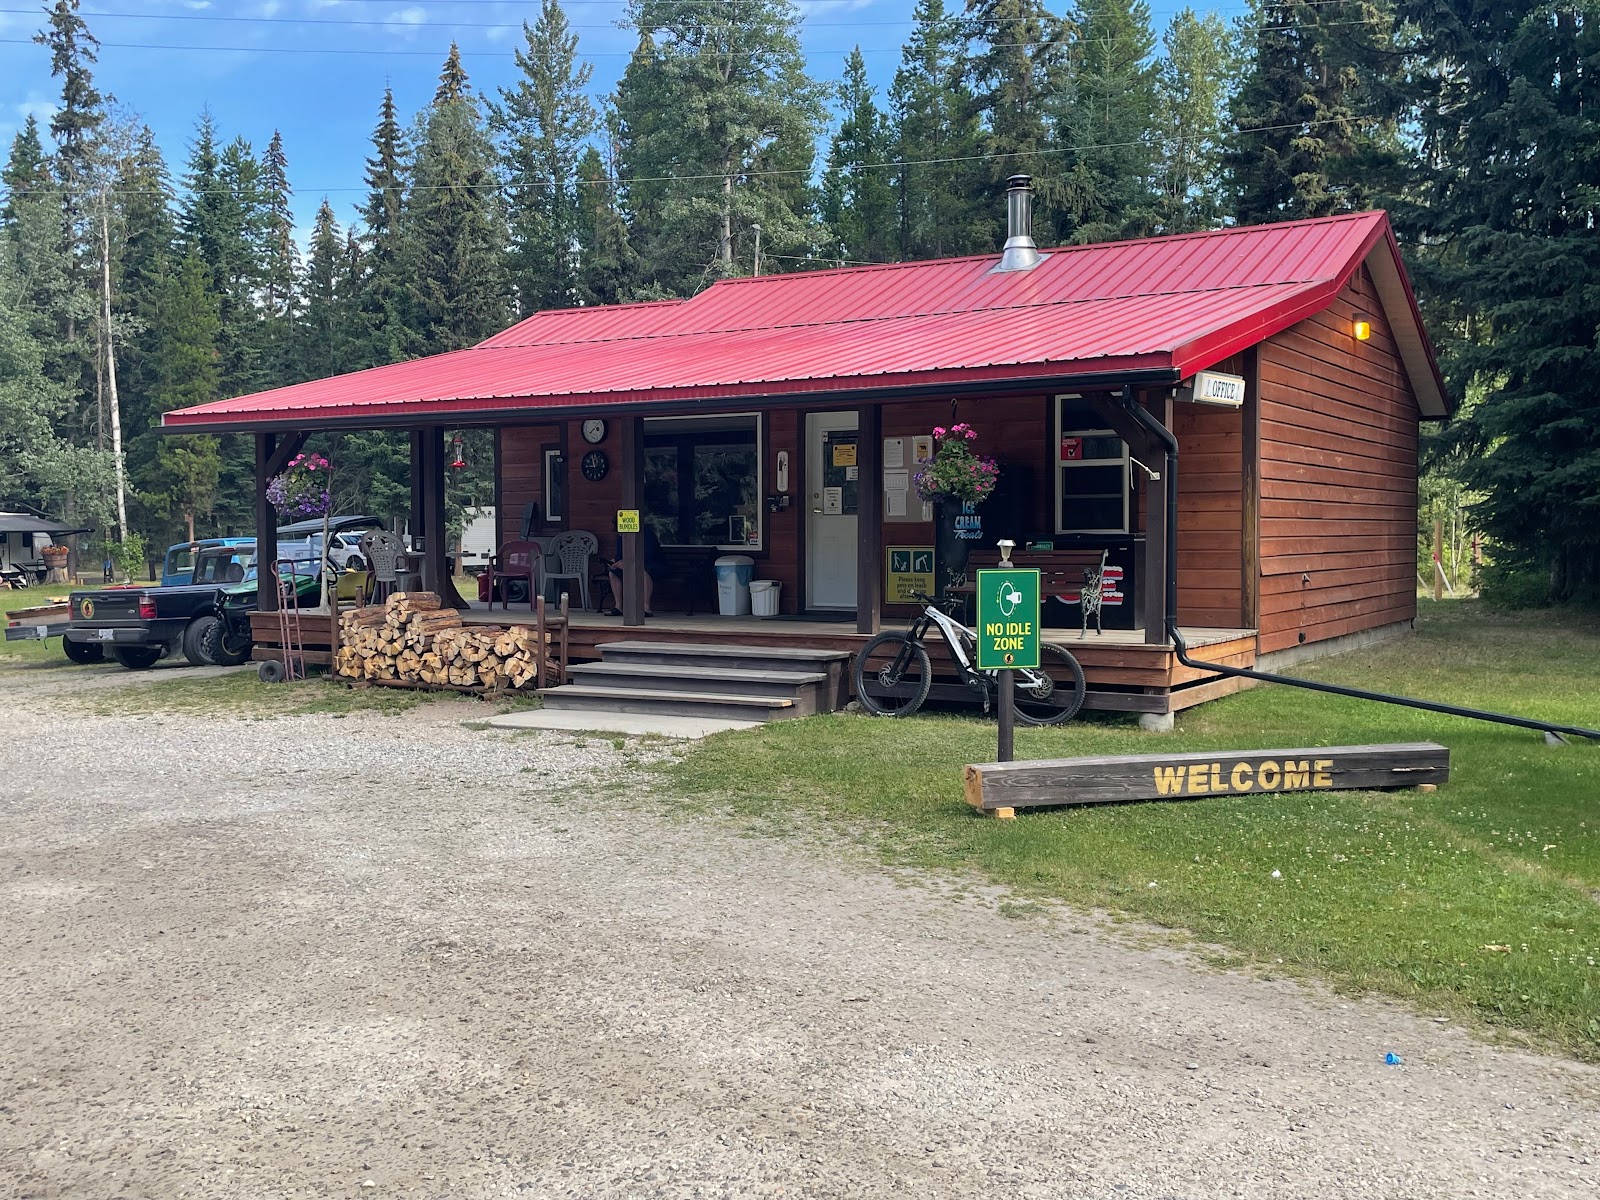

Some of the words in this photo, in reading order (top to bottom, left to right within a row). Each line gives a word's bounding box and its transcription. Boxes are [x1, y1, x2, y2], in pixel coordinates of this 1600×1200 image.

[1212, 380, 1236, 400] OFFICE
[962, 500, 976, 515] ICE
[954, 515, 982, 530] CREAM
[953, 529, 984, 540] Treats
[986, 623, 1004, 636] NO
[1006, 622, 1032, 636] IDLE
[993, 637, 1025, 651] ZONE
[1153, 759, 1334, 796] WELCOME
